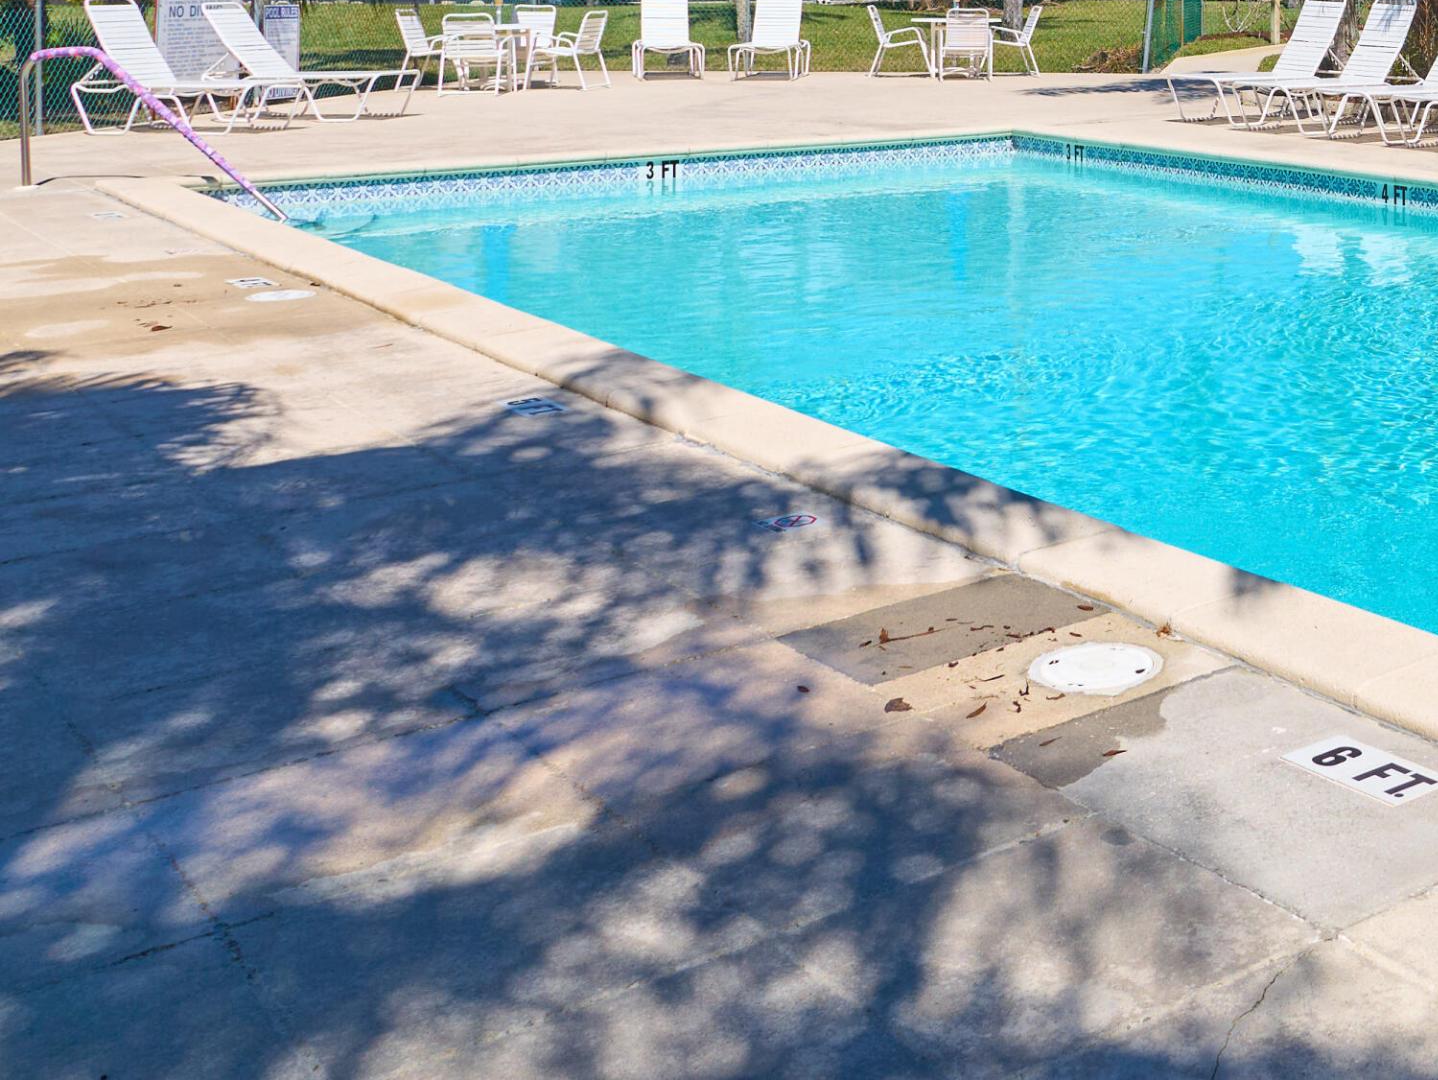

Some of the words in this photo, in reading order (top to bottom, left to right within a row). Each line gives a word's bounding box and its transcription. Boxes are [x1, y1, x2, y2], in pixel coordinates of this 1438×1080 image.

[169, 6, 185, 18] NO
[265, 8, 280, 18] POOL
[281, 7, 298, 17] RULES
[1066, 144, 1071, 160] 3
[1074, 145, 1084, 161] FT
[646, 161, 654, 179] 3
[661, 160, 680, 179] FT
[1381, 183, 1389, 204] 4
[1393, 184, 1408, 206] FT
[1311, 746, 1363, 767] 6
